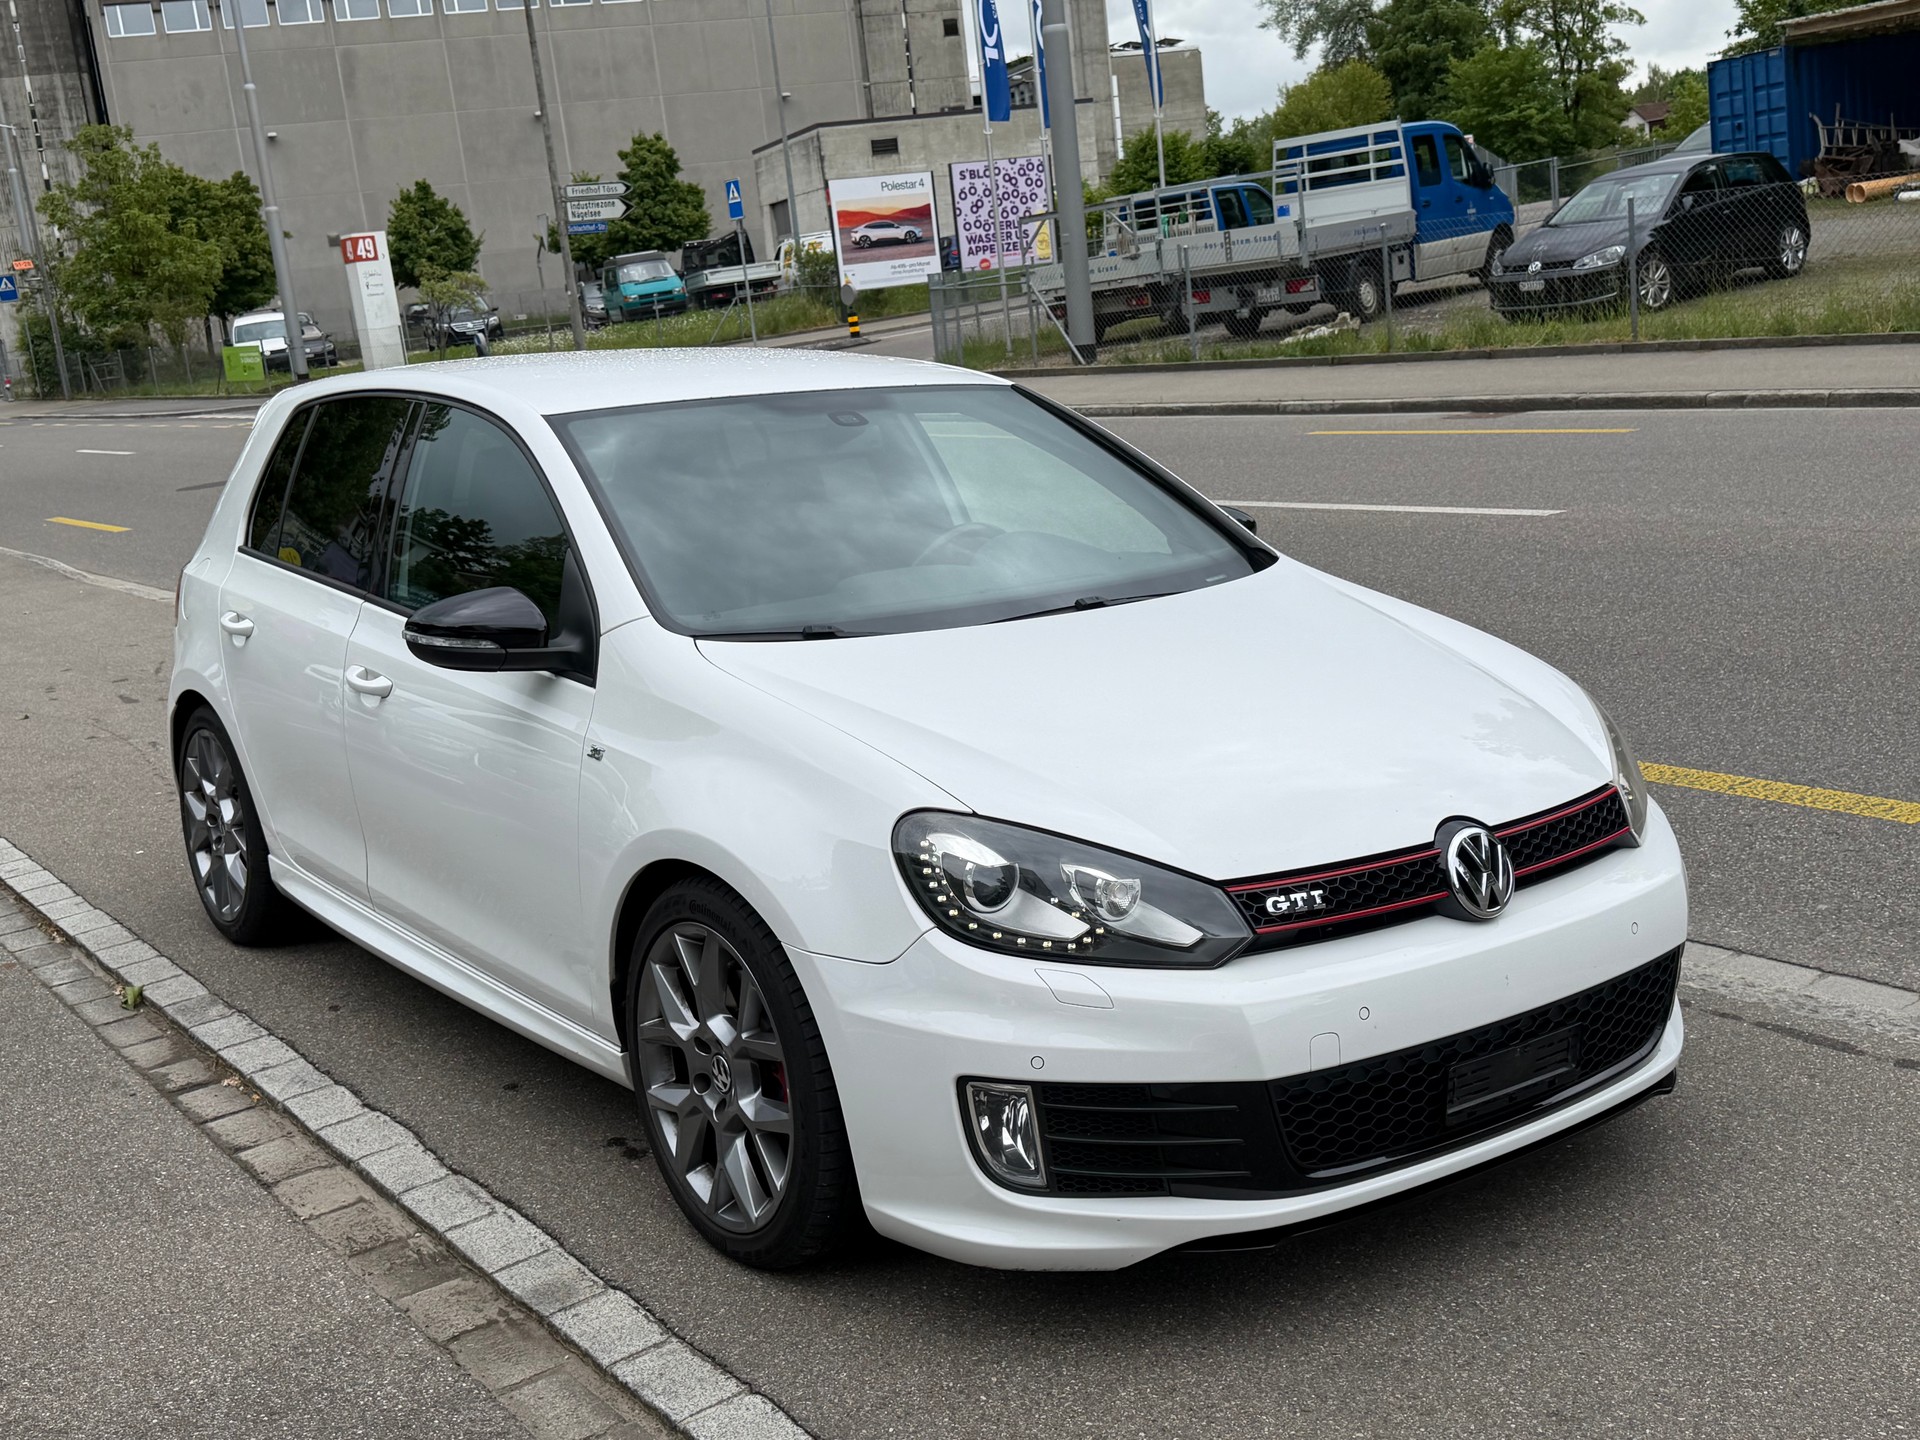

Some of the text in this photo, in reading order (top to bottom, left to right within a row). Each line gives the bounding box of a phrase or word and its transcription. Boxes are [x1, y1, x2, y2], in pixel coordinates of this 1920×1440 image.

[571, 185, 618, 195] Friedhof Töss
[881, 178, 925, 191] Polestar 4
[571, 200, 615, 210] Industriezone
[571, 210, 601, 221] Nägelsee
[965, 231, 1013, 245] WASSER
[356, 237, 375, 259] 49
[1265, 889, 1327, 916] GTI
[688, 899, 733, 933] Continental
